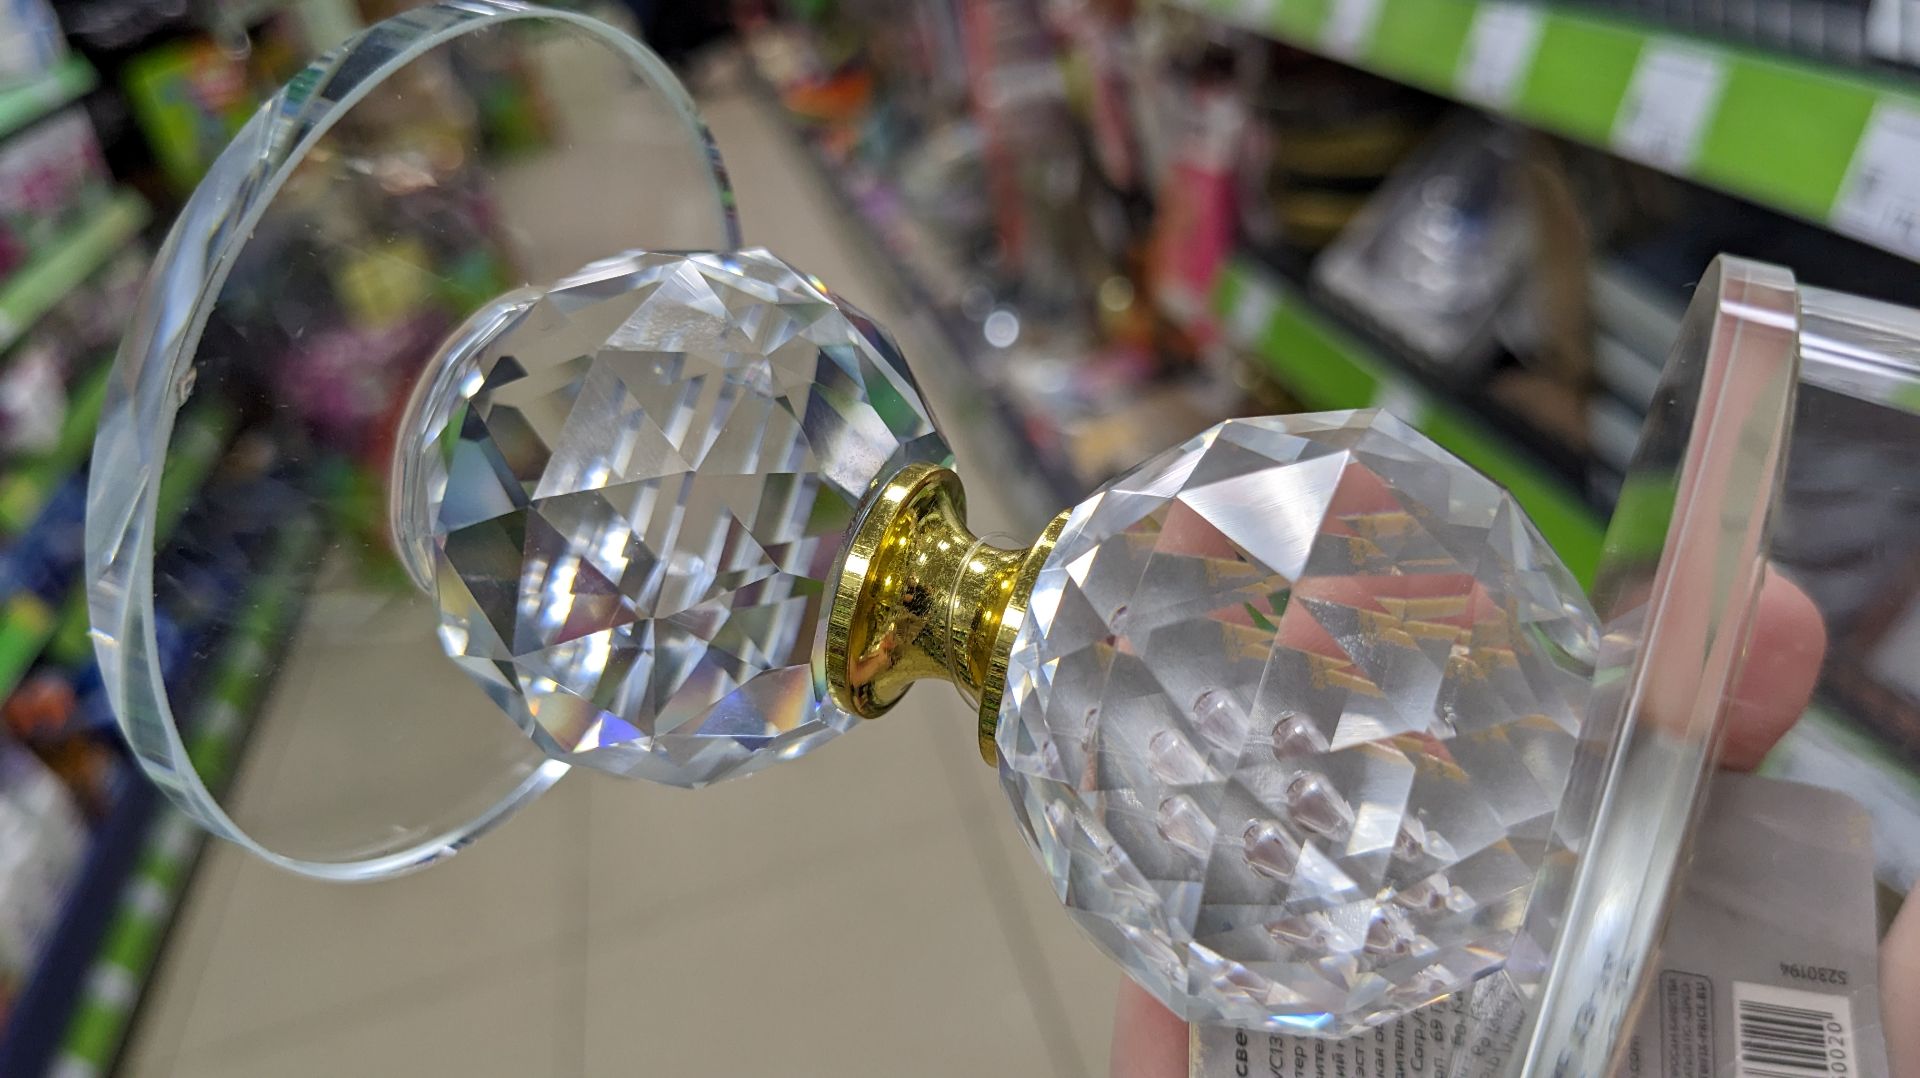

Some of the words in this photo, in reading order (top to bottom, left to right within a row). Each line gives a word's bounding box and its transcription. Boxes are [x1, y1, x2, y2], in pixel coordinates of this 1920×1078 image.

[1779, 962, 1848, 986] 5230194
[1430, 1018, 1444, 1042] 69
[1628, 1035, 1642, 1078] .com
[1826, 1022, 1848, 1078] 0020
